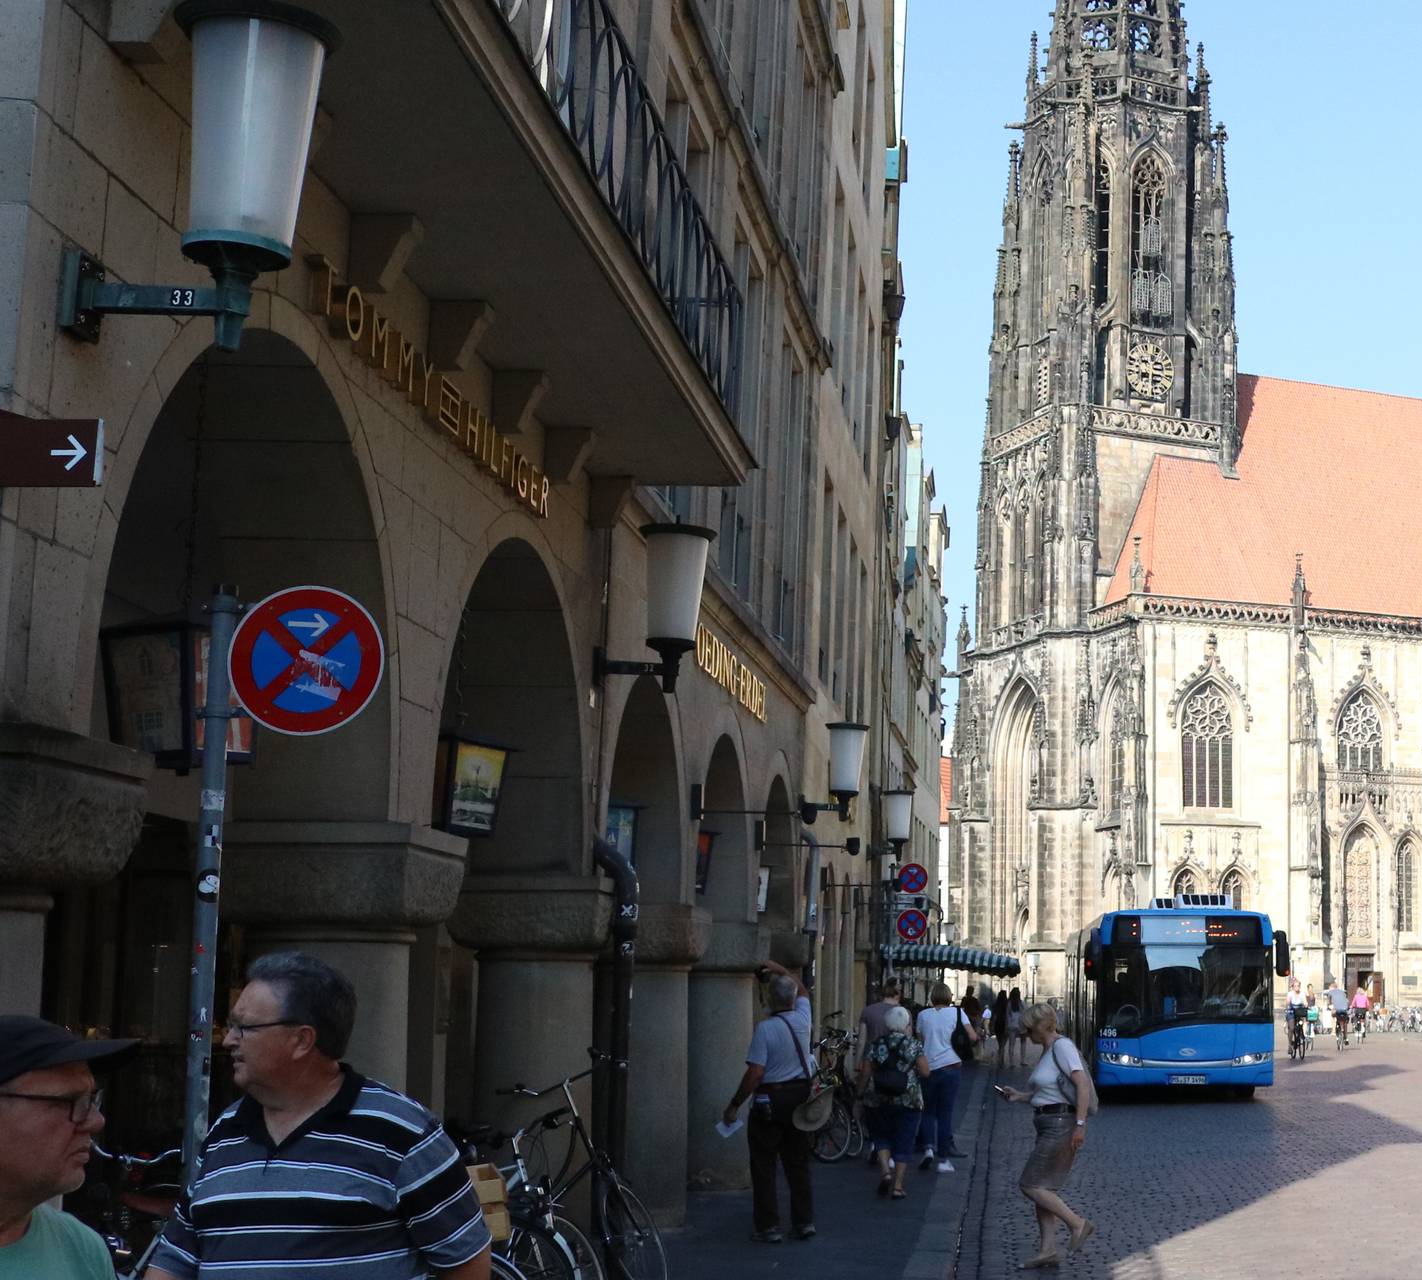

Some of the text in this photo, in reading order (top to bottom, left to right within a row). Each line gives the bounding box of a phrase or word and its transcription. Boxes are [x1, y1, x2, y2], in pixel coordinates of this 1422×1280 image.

[172, 289, 193, 306] 33
[321, 255, 550, 519] TOMMY HILFIGER
[695, 621, 768, 724] OEDING-ERDEL
[1099, 1028, 1117, 1037] 1496
